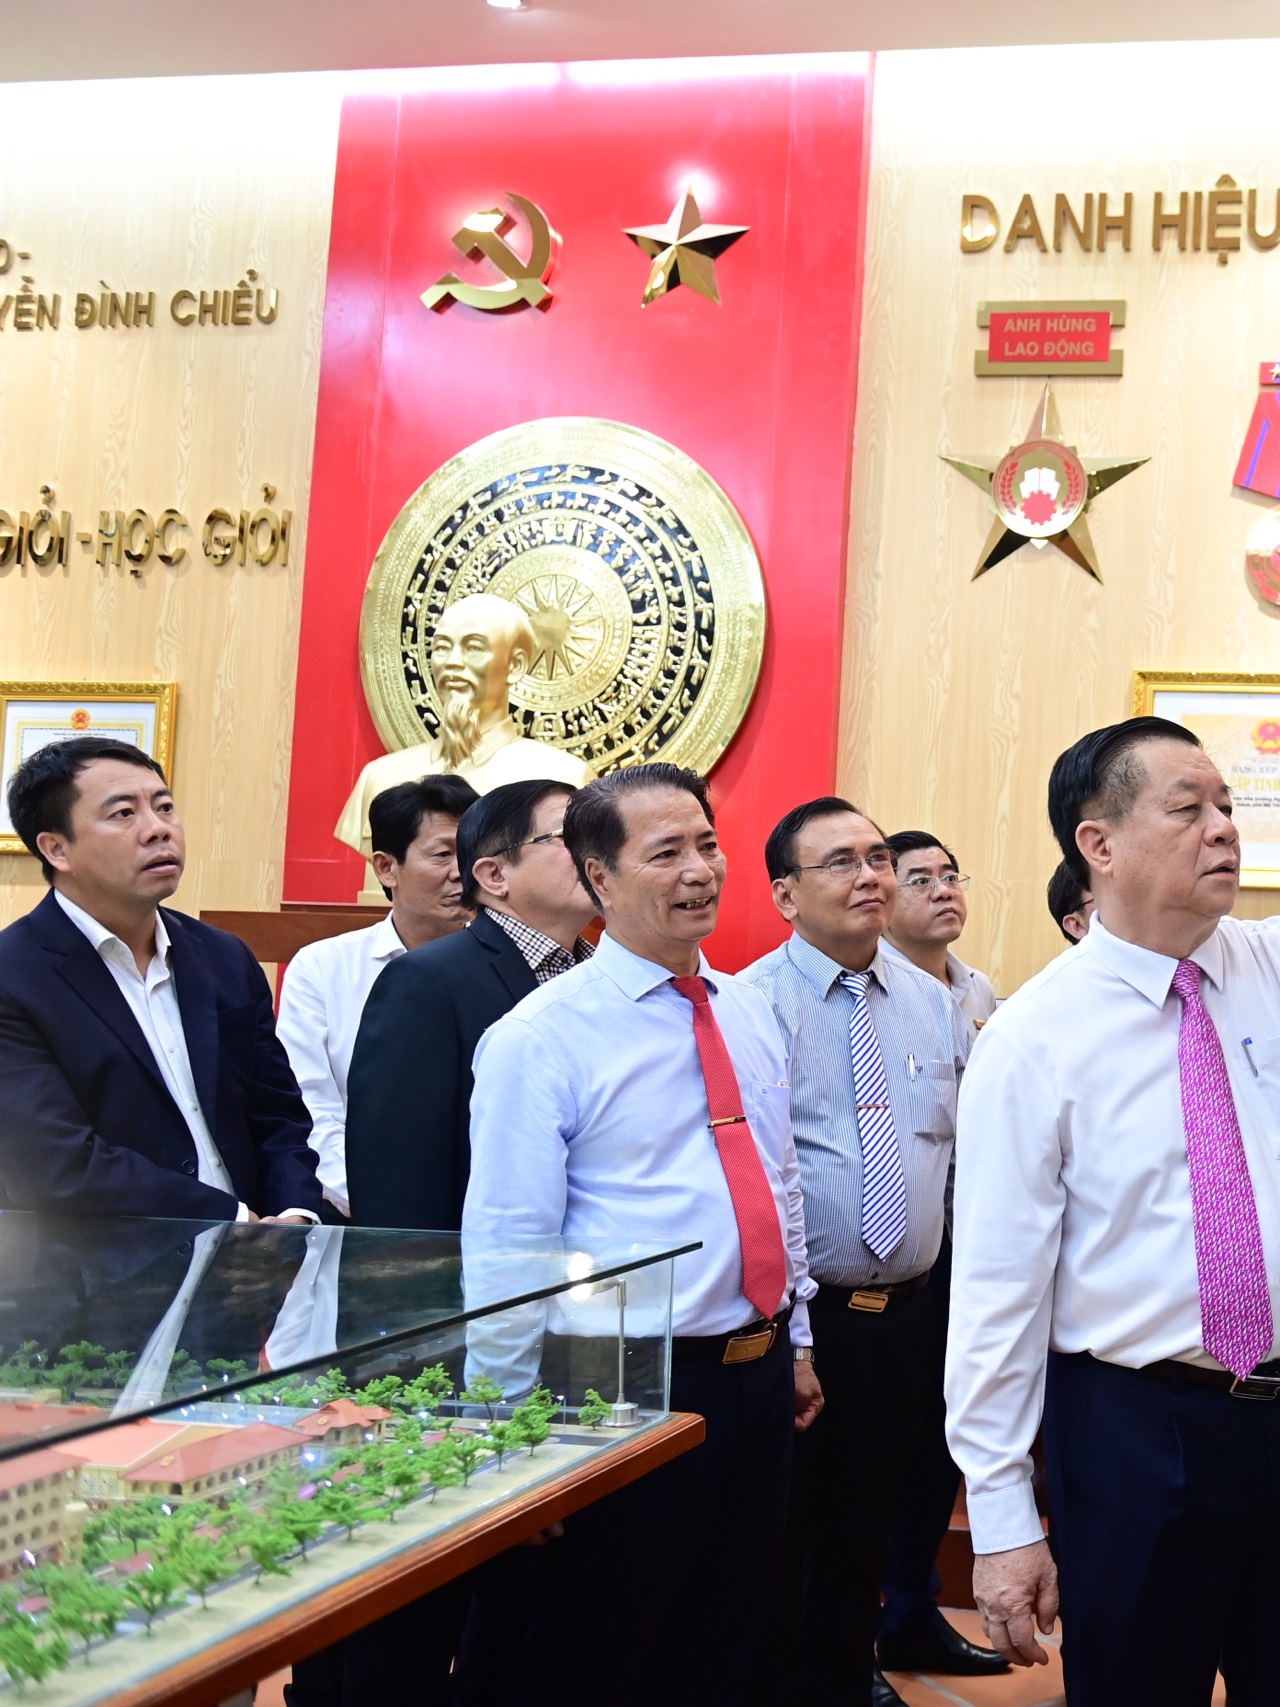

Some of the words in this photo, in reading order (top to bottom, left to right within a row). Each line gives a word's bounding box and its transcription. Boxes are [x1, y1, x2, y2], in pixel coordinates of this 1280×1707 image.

[960, 192, 1134, 253] DANH
[75, 280, 155, 329] ĐÌNH
[171, 269, 279, 326] CHIỂU
[1004, 318, 1041, 333] ANH
[1046, 315, 1096, 333] HÙNG
[1004, 342, 1039, 356] LAO
[1044, 339, 1094, 358] ĐỘNG
[203, 483, 292, 567] GIỎI
